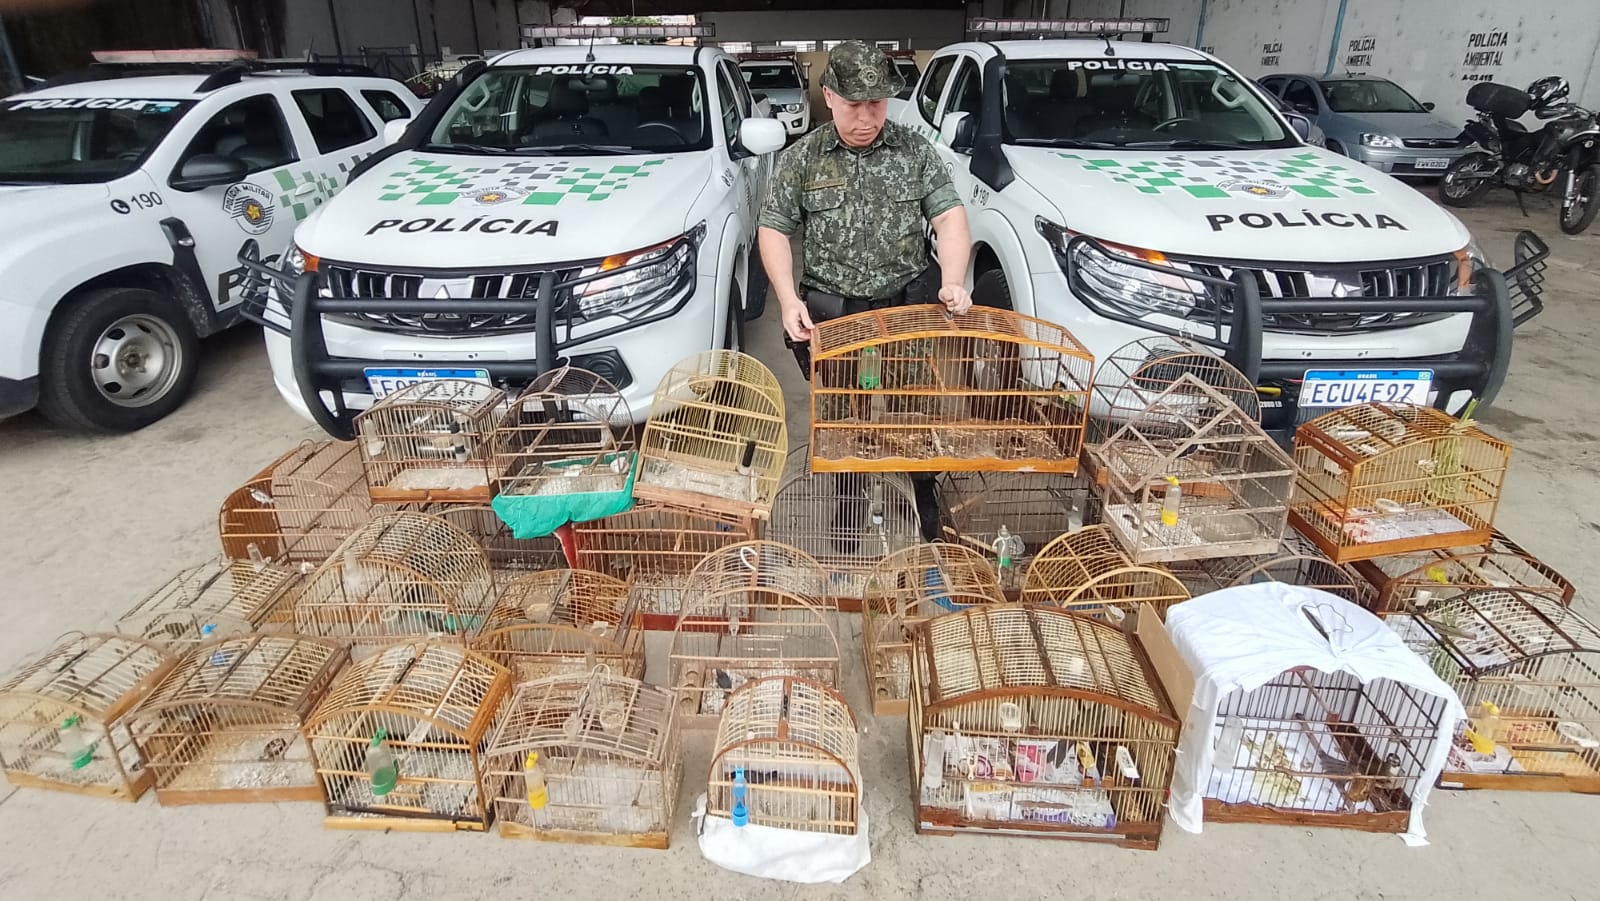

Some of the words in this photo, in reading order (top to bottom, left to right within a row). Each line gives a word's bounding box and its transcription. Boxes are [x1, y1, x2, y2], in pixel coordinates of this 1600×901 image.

[1467, 27, 1508, 48] POLÍCIA
[1067, 59, 1171, 72] POLÍCIA
[1463, 51, 1503, 66] AMBIENTAL
[535, 63, 634, 76] POLÍCIA
[131, 191, 164, 210] 190
[365, 214, 560, 237] POLÍCIA
[1206, 209, 1410, 232] POLÍCIA
